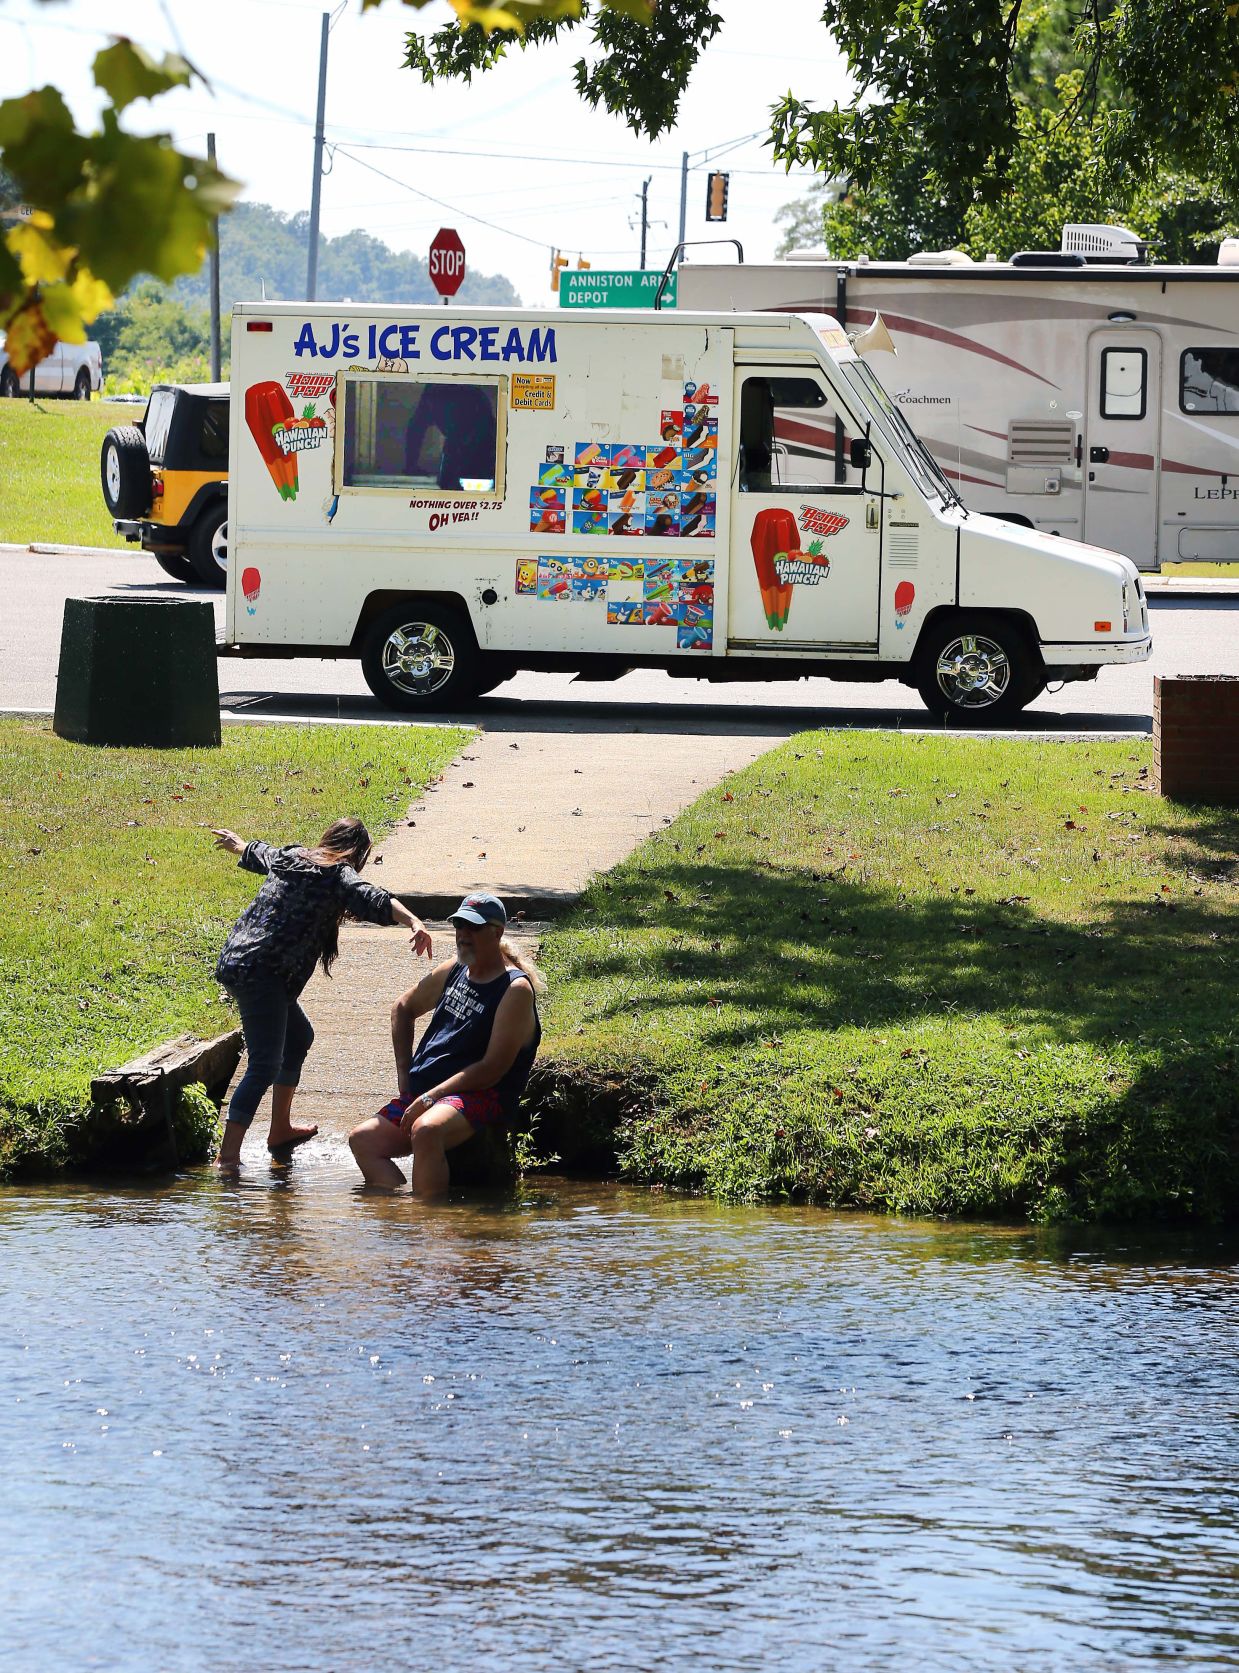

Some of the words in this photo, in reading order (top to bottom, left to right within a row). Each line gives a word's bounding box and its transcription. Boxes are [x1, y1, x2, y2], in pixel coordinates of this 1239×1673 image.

[431, 249, 464, 276] STOP
[569, 275, 633, 287] ANNISTON
[568, 291, 609, 304] DEPOT
[368, 324, 421, 360] ICE
[430, 325, 558, 363] CREAM
[292, 386, 327, 397] POP
[524, 390, 545, 398] Credit
[514, 398, 533, 406] Debit
[534, 399, 552, 407] Cards
[898, 395, 952, 404] Coachmen
[275, 427, 328, 447] HAWAIIAN
[282, 437, 321, 455] PUNCH
[409, 500, 452, 509] NOTHING
[453, 501, 478, 510] OVER
[479, 501, 503, 510] $2.75
[428, 513, 449, 532] OH
[802, 520, 839, 536] POP
[775, 560, 831, 579] HAWAIIAN
[780, 573, 820, 586] PUNCH
